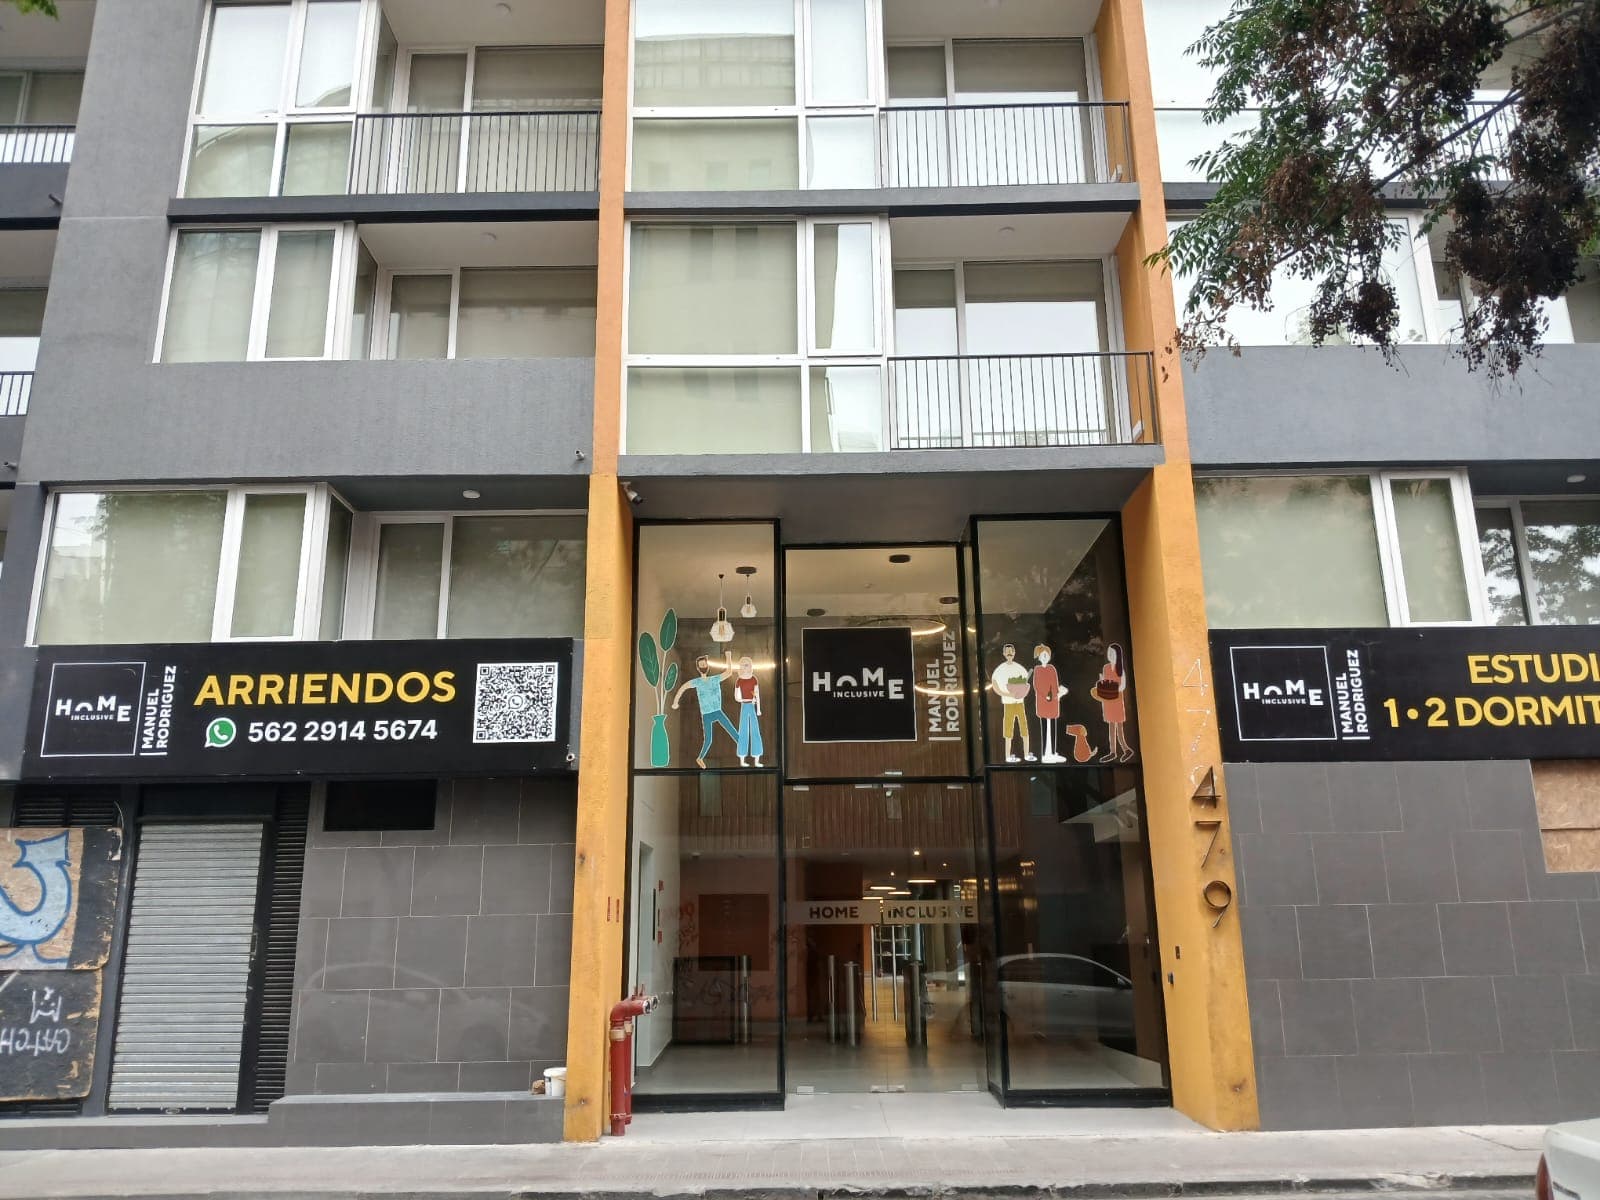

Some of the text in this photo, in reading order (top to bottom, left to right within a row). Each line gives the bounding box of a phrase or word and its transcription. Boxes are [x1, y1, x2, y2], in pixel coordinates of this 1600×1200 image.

[812, 667, 905, 700] HOME
[942, 630, 960, 732] RODRIGUEZ
[1467, 652, 1600, 684] ESTUDI
[193, 671, 456, 706] ARRIENDOS
[833, 690, 885, 698] INCLUSIVE
[926, 658, 943, 732] MANUEL
[1243, 679, 1324, 706] HOME
[1335, 672, 1354, 733] MANUEL
[1346, 649, 1369, 733] RODRIGUEZ
[55, 695, 132, 722] HOME
[141, 688, 160, 749] MANUEL
[156, 665, 177, 749] RODRIGUEZ
[1454, 695, 1600, 727] DORMIT
[247, 719, 438, 743] 562 2914 5674
[1191, 765, 1232, 929] 479
[809, 906, 860, 919] HOME
